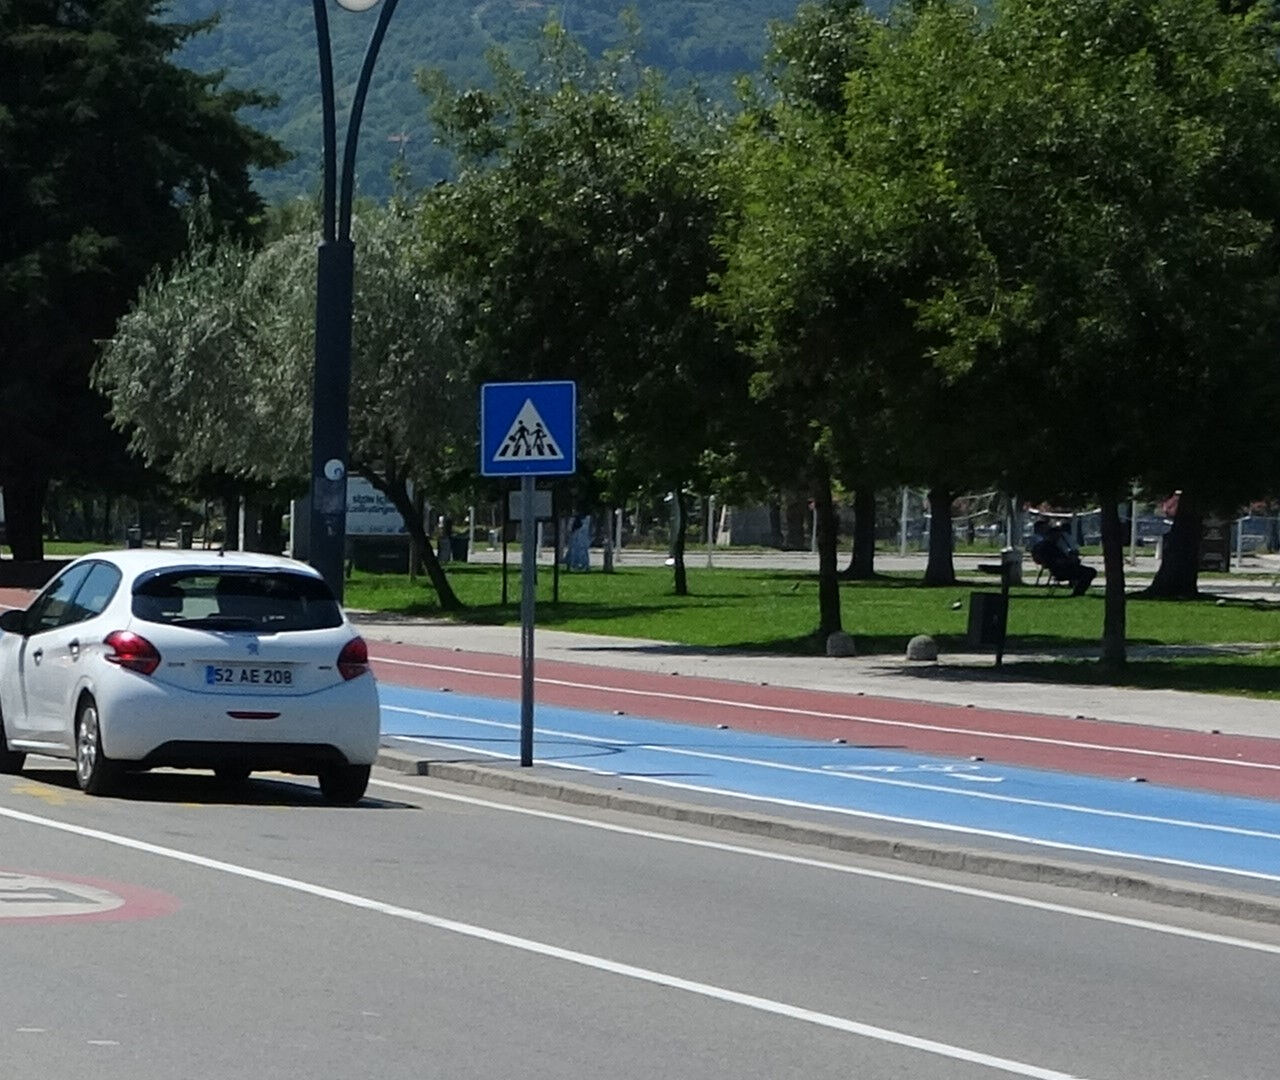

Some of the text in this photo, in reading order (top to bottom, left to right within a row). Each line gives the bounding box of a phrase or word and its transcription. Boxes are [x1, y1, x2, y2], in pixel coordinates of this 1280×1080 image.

[214, 668, 292, 684] 52 AE 208
